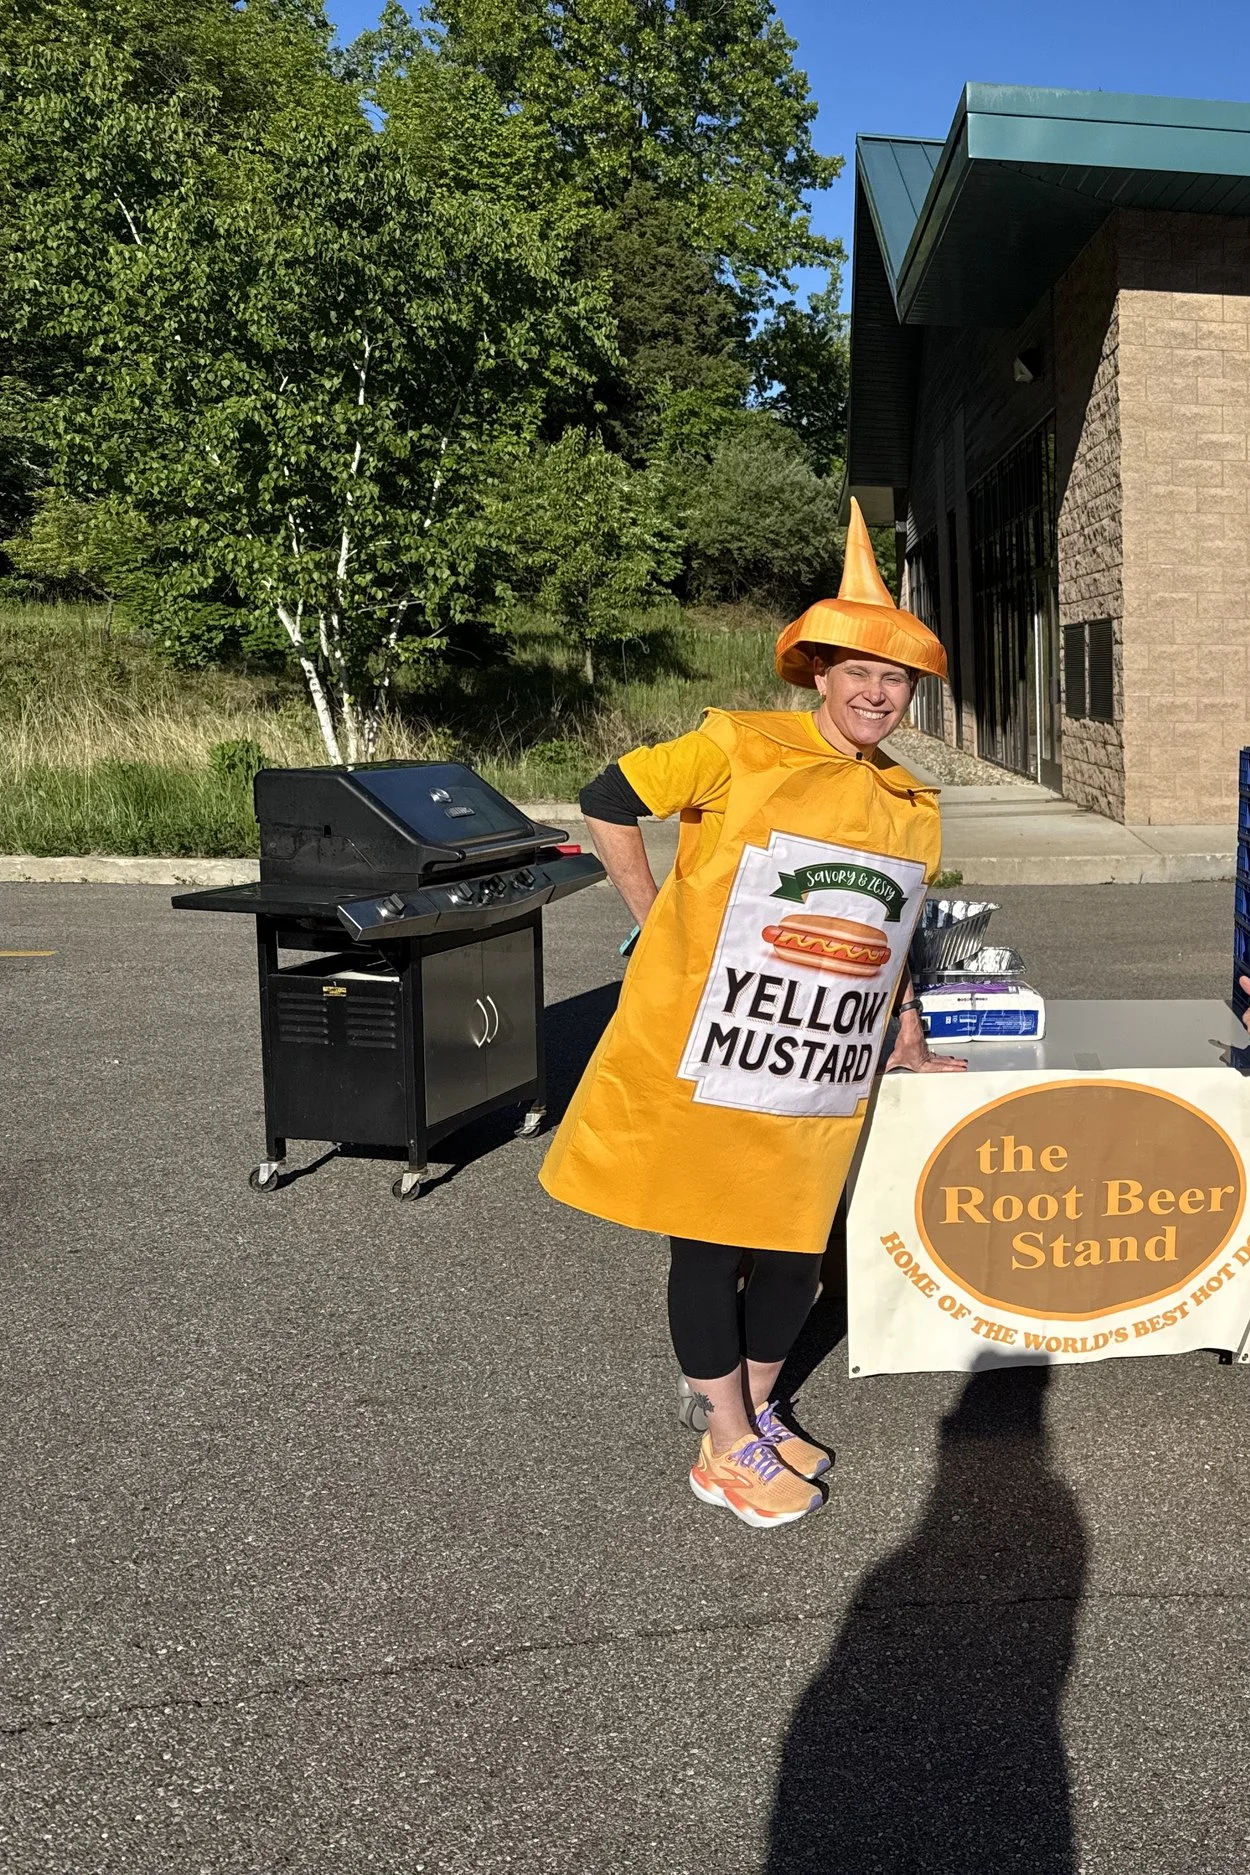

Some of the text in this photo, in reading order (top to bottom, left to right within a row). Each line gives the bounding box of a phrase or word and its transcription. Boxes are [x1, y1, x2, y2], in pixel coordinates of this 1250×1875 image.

[858, 872, 868, 887] &
[722, 966, 889, 1035] YELLOW
[700, 1021, 873, 1084] MUSTARD
[975, 1135, 1069, 1175] the
[938, 1178, 1235, 1224] Root Beer
[1011, 1225, 1180, 1271] Stand
[879, 1231, 941, 1299] HOME
[937, 1294, 973, 1321] OF
[970, 1316, 1019, 1346] THE
[1023, 1326, 1129, 1354] WORLD'S
[1132, 1300, 1192, 1338] BEST
[1189, 1262, 1237, 1307] HOT
